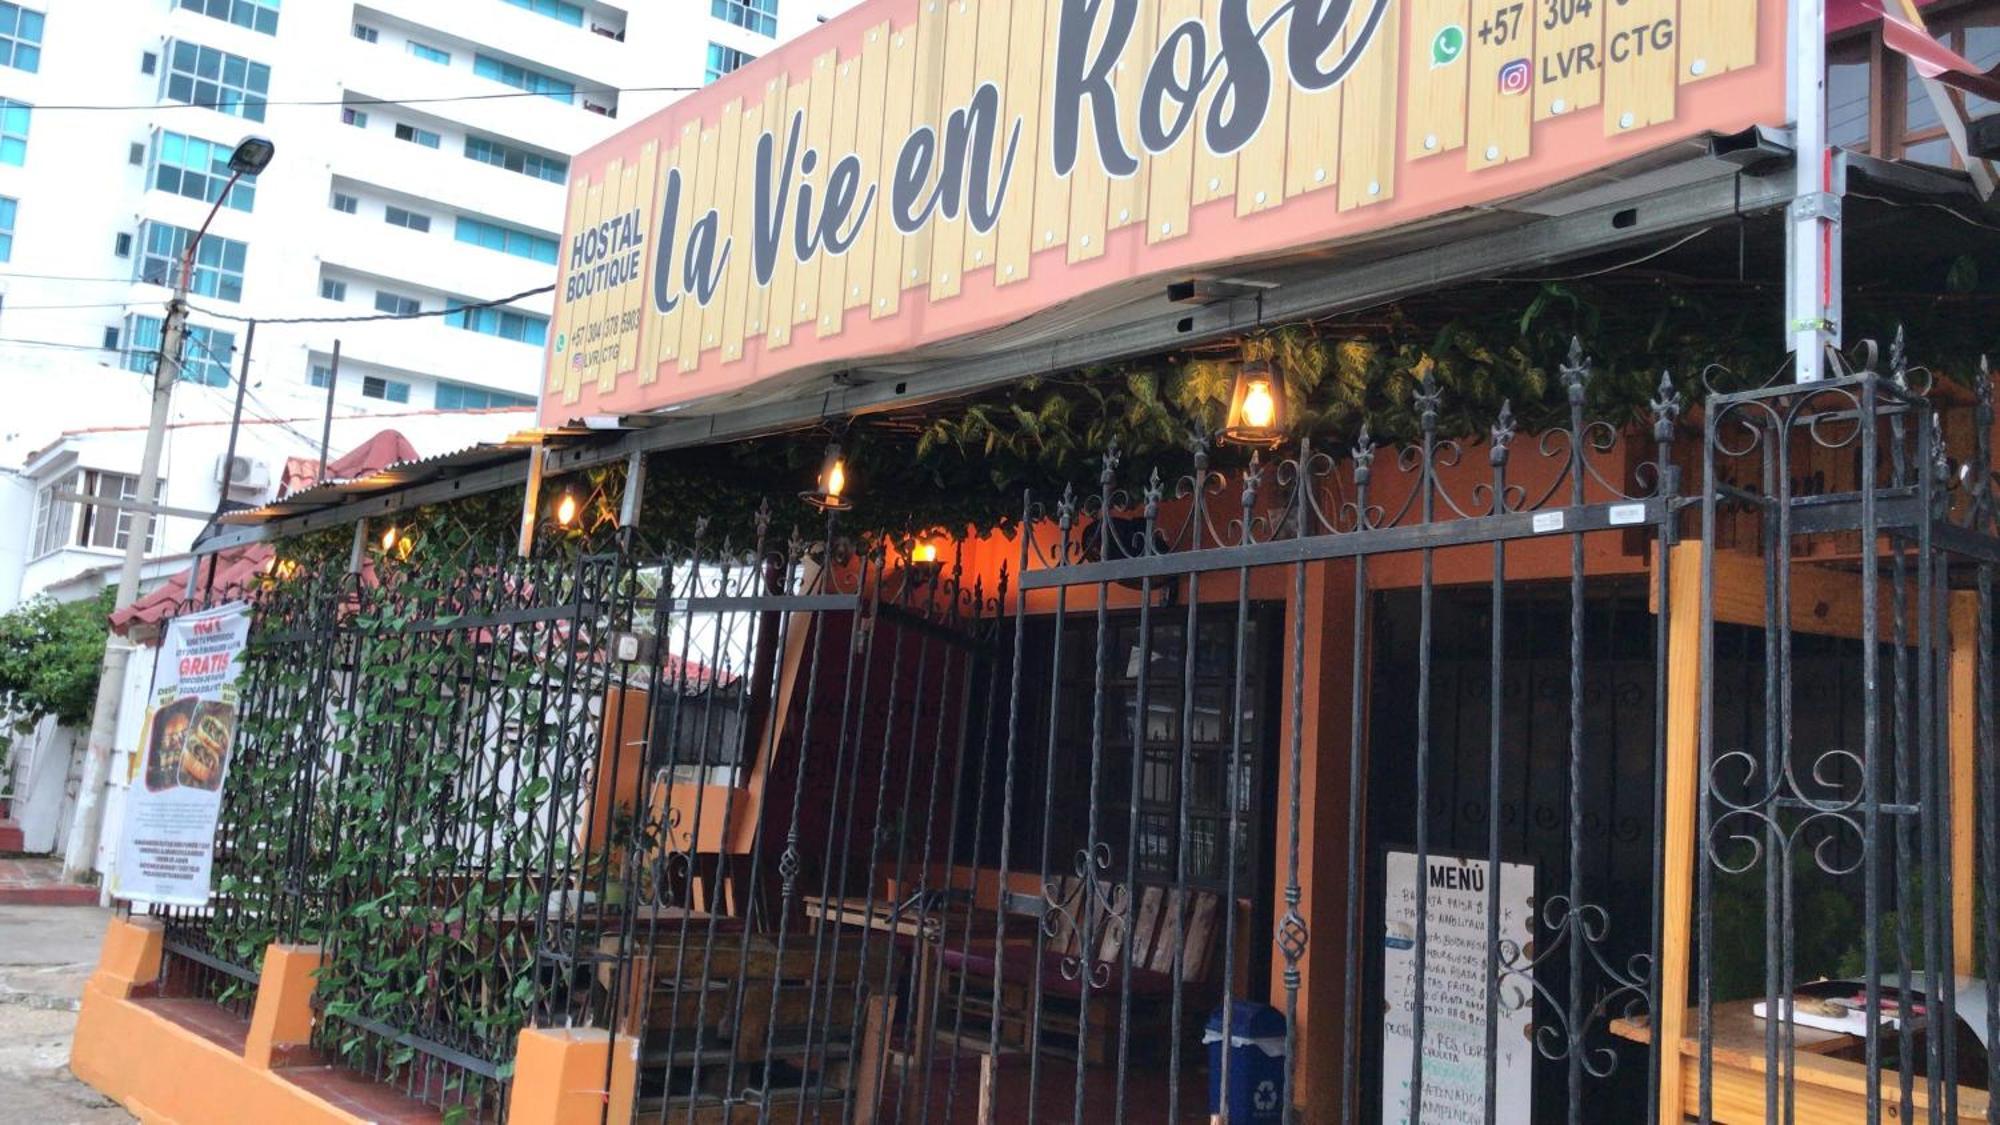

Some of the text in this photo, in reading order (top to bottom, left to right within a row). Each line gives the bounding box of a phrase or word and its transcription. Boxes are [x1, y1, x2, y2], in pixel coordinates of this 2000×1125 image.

[1478, 3, 1524, 46] +57
[753, 108, 877, 287] Vie
[891, 81, 1022, 235] en
[1053, 0, 1389, 179] Rose
[570, 209, 643, 271] HOSTAL
[566, 251, 640, 303] BOUTIQUE
[587, 322, 601, 344] 304
[179, 652, 230, 677] GRATIS
[1429, 863, 1485, 892] MENÚ
